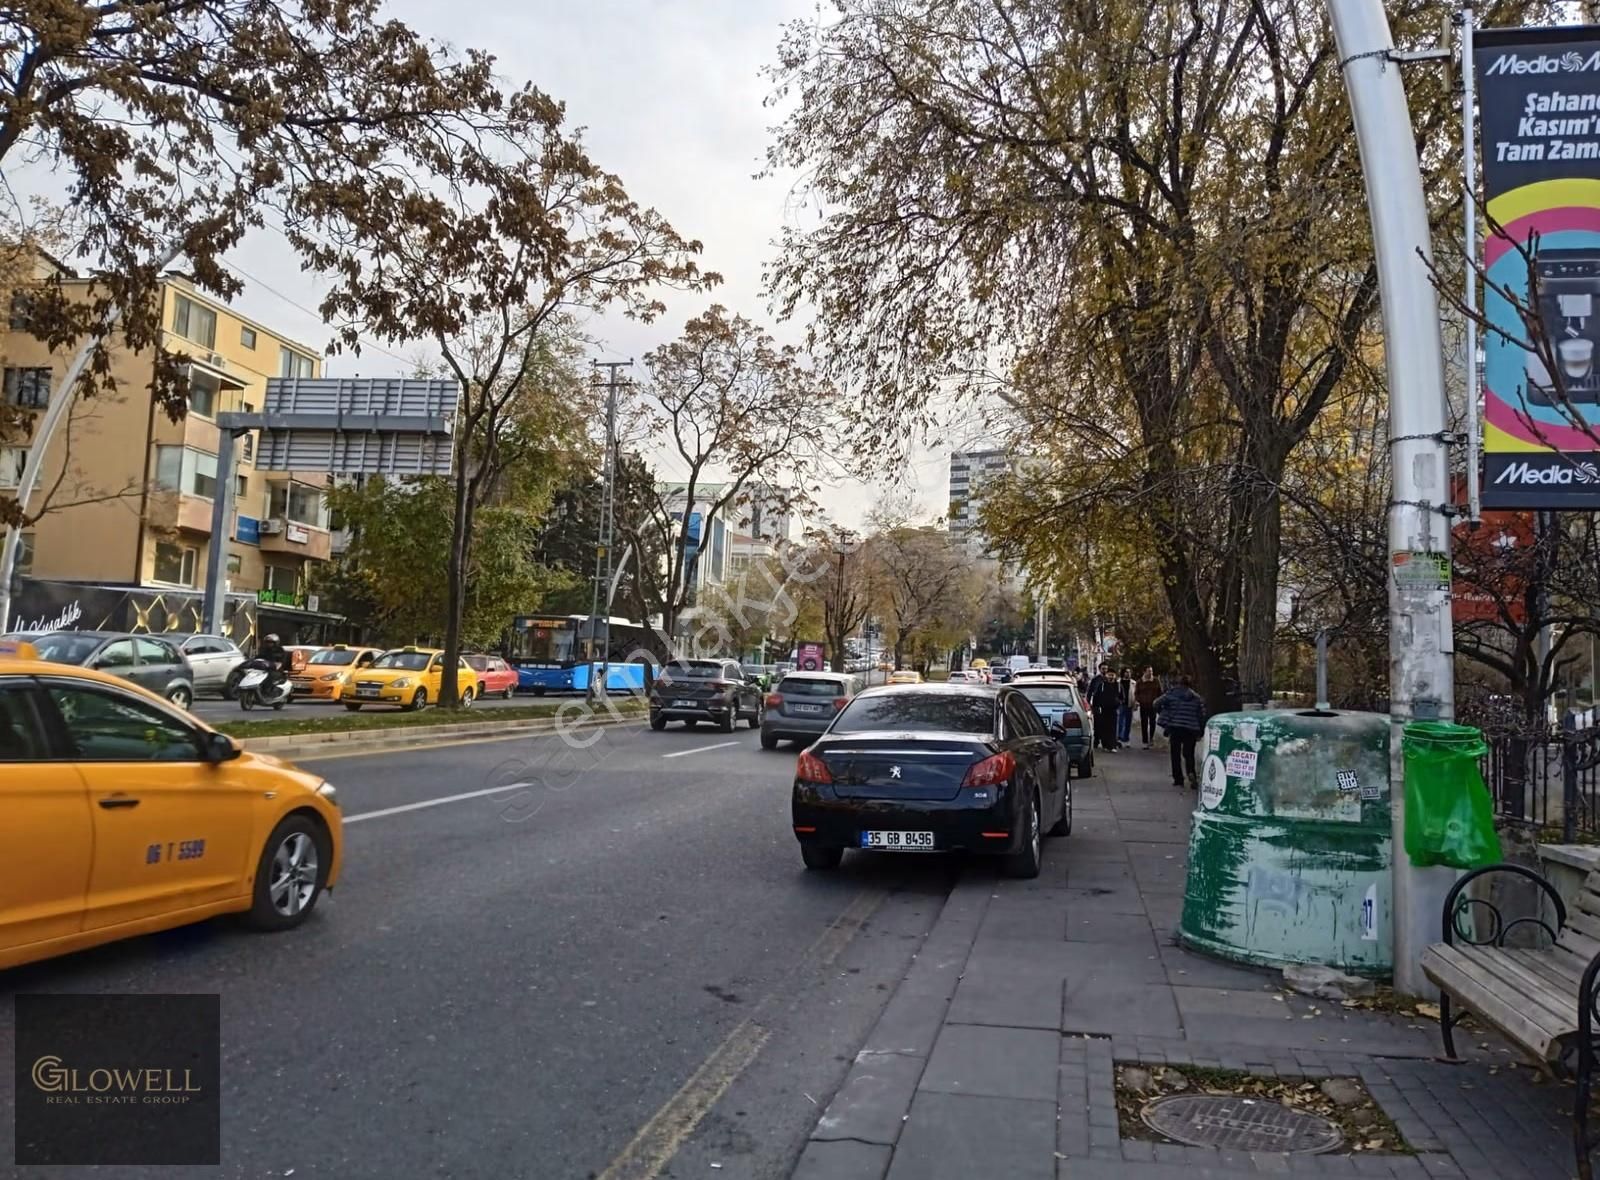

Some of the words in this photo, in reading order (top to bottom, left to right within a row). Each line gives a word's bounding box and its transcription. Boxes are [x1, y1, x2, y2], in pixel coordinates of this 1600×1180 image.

[1485, 53, 1559, 76] Media
[1496, 141, 1544, 162] Tam
[1547, 140, 1600, 161] Zam
[1493, 462, 1573, 484] Media
[869, 832, 881, 844] 35
[887, 832, 900, 845] GB
[905, 832, 932, 845] 8496
